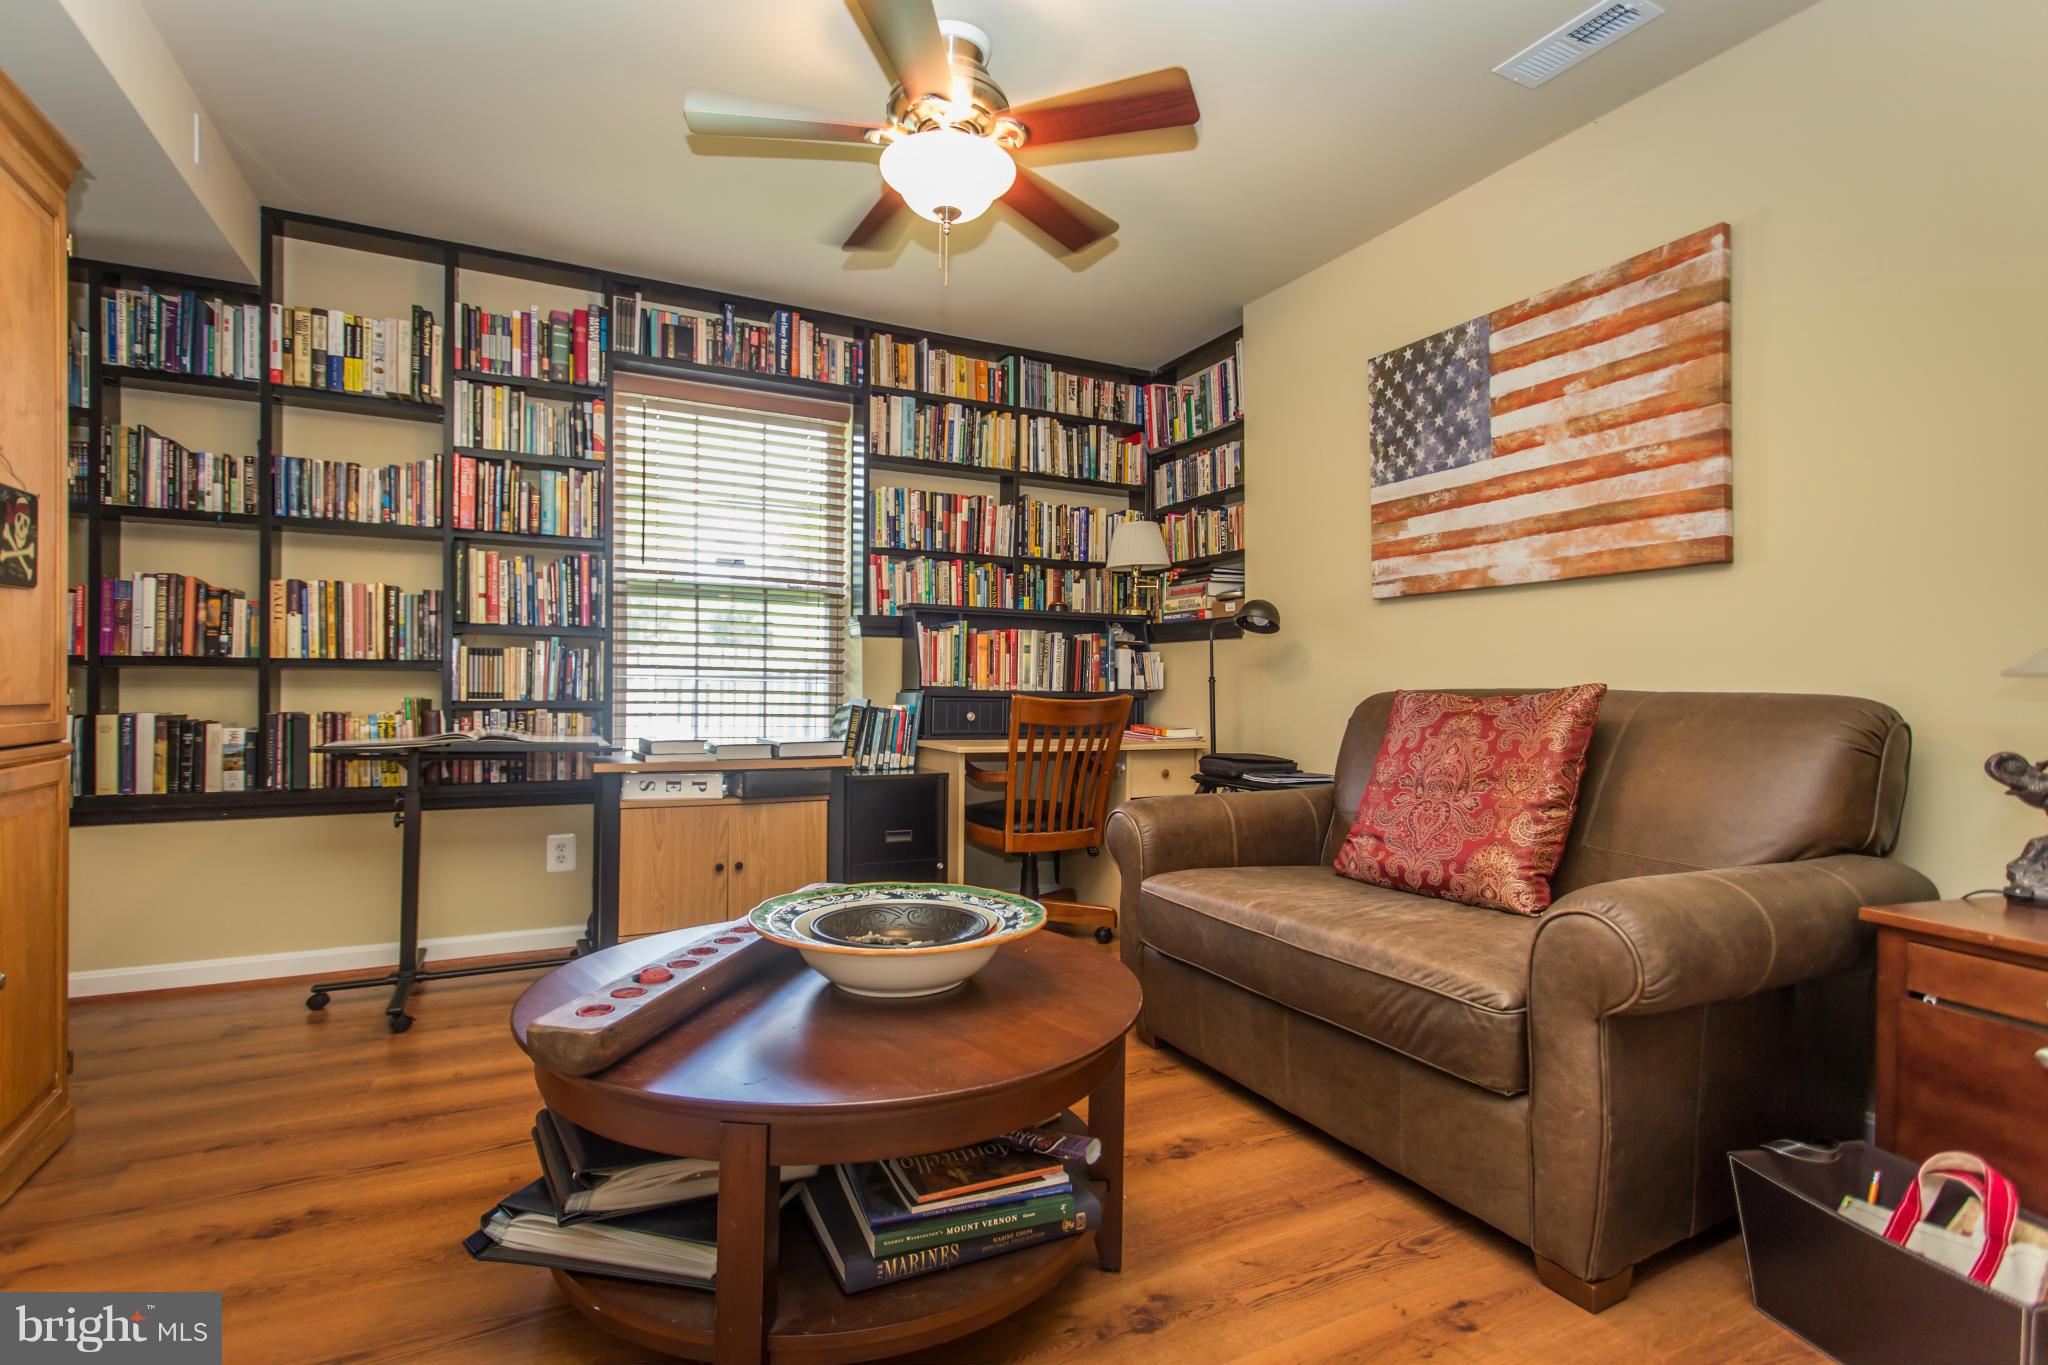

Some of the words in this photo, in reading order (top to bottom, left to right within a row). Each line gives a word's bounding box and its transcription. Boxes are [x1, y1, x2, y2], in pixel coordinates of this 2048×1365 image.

[273, 583, 283, 624] PAUL
[922, 1208, 949, 1217] GEORGE
[951, 1202, 988, 1213] WASHINGTON
[946, 1222, 980, 1235] MOUNT
[982, 1214, 1018, 1227] VERNON
[992, 1233, 1014, 1243] MARINE
[883, 1243, 960, 1279] MARINES
